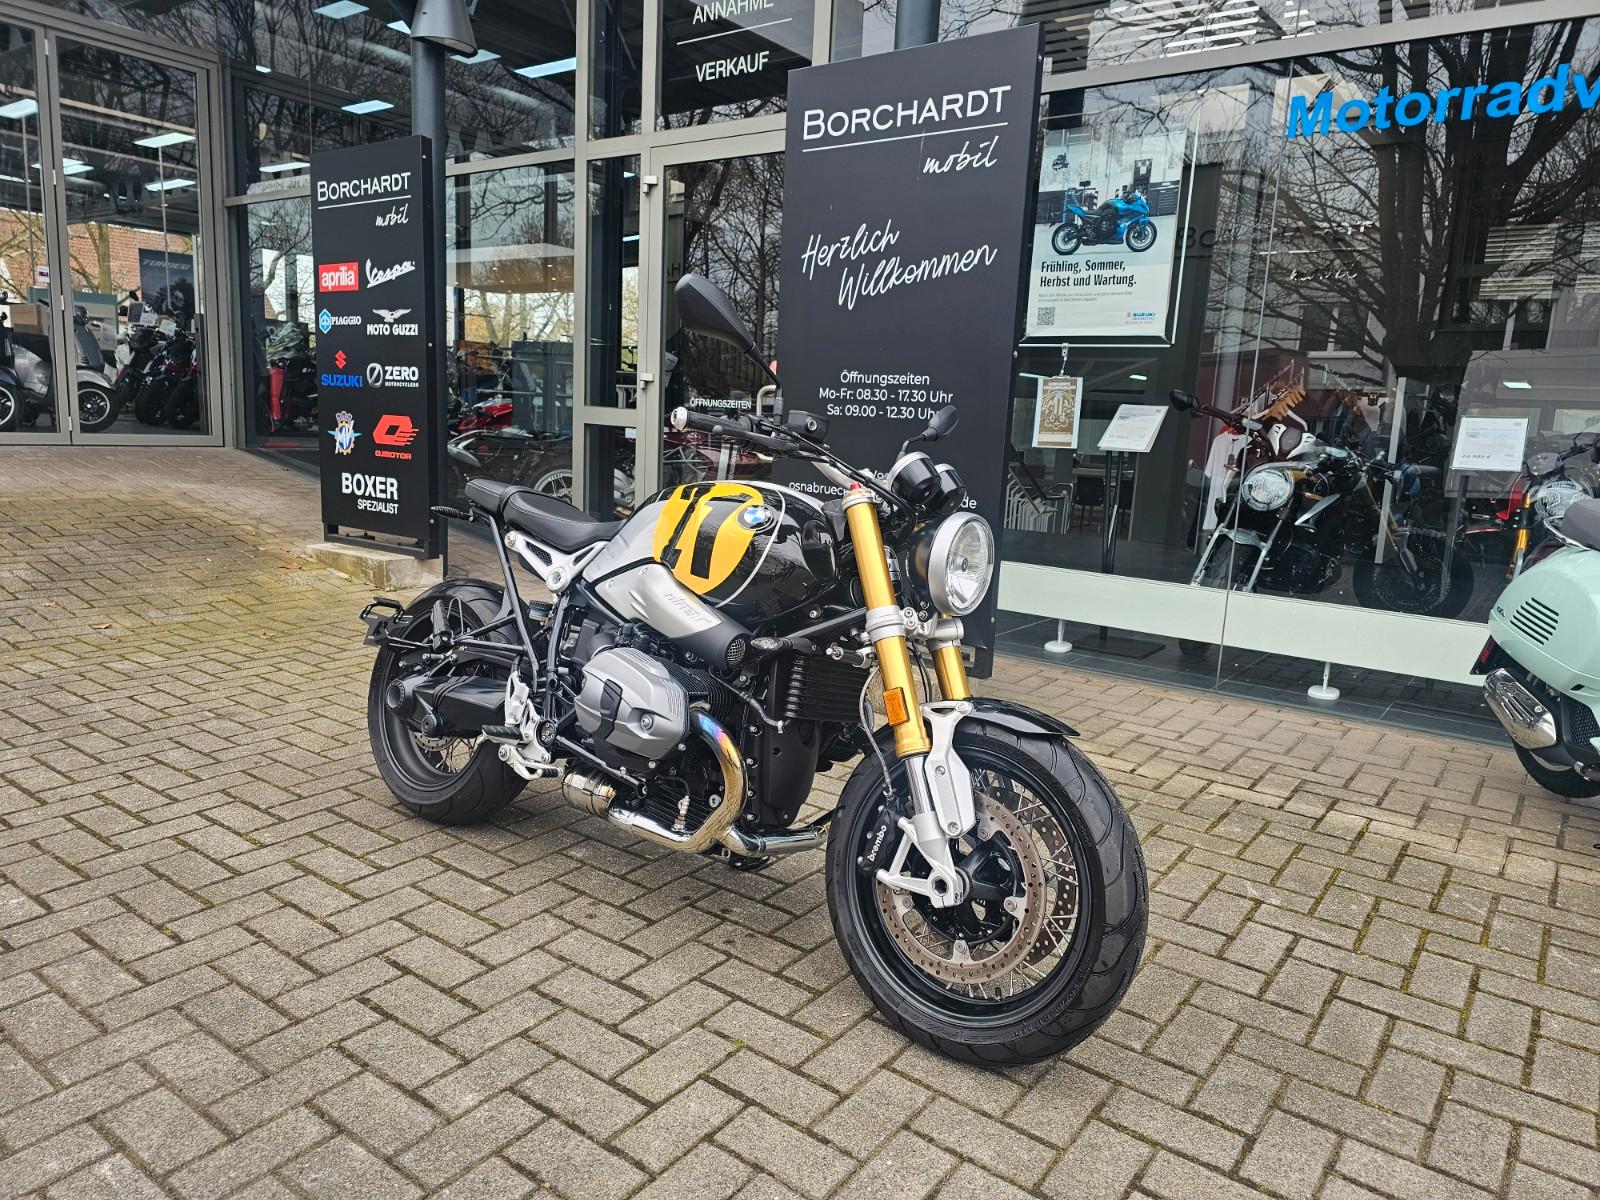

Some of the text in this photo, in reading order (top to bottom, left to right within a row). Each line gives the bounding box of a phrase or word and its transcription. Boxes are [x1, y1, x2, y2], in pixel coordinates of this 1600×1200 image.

[695, 50, 770, 82] VERKAUF
[1287, 62, 1600, 138] Motorradv
[923, 135, 999, 174] mobil
[375, 203, 409, 227] mobil
[801, 219, 900, 280] Herzlich
[365, 258, 416, 289] Vespa
[1041, 260, 1126, 274] Frühling, Sommer,
[321, 266, 356, 291] aprilia
[838, 244, 998, 311] Willkommen
[1040, 274, 1137, 288] Herbst und Wartung.
[331, 316, 361, 326] PIAGGIO
[366, 324, 419, 336] MOTO GUZZI
[321, 374, 363, 388] SUZUKI
[384, 366, 419, 381] ZERO
[840, 369, 930, 387] Öffnungszeiten
[689, 397, 752, 409] ÖFFNUNGSZEITEN
[819, 387, 854, 400] Mo-Fr:
[856, 388, 888, 401] 08.30
[898, 389, 927, 403] 17.30
[929, 390, 954, 404] Uhr
[826, 404, 842, 416] Sa:
[844, 405, 876, 418] 09.00
[886, 406, 915, 419] 12.30
[341, 472, 399, 500] BOXER
[357, 499, 399, 515] SPEZIALIST
[867, 825, 887, 862] brembo
